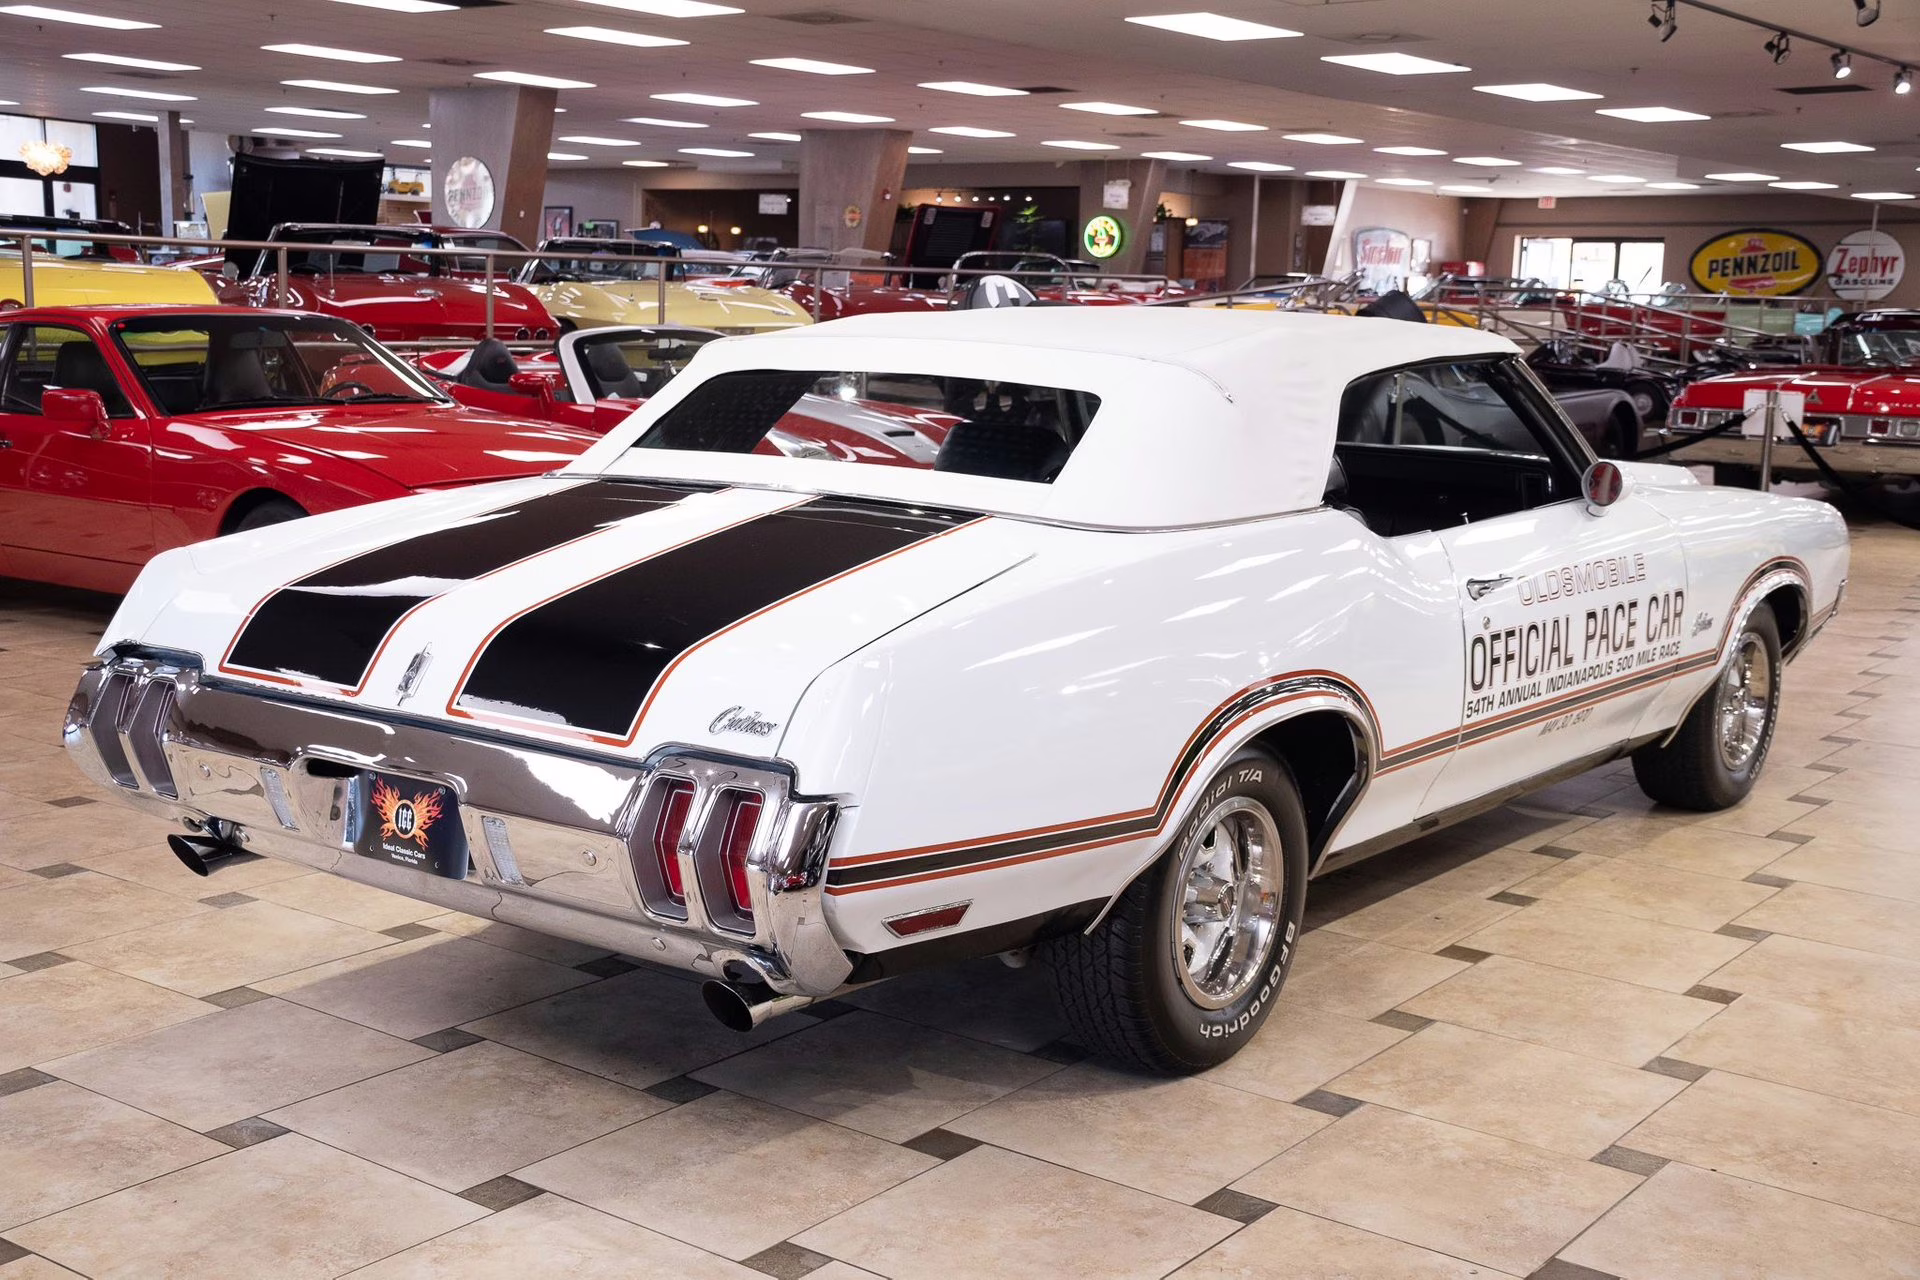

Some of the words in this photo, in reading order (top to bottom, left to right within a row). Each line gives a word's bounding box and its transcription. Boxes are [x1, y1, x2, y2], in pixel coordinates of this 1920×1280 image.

[447, 186, 490, 202] PENNZO
[1707, 250, 1801, 279] PENNZOIL
[1836, 246, 1900, 278] Zephyr
[1834, 277, 1895, 286] GASOLINE
[1517, 552, 1646, 606] OLDSMOBILE
[1470, 613, 1575, 694] OFFICIAL
[1583, 598, 1639, 662] PACE
[1645, 587, 1685, 644] CAR
[1466, 694, 1495, 719] 54TH
[1498, 680, 1542, 709] ANNUAL
[1545, 660, 1614, 695] INDIANAPOLIS
[1616, 653, 1634, 673] 500
[1636, 647, 1657, 666] MILE
[1658, 641, 1681, 659] RACE
[708, 704, 779, 737] Cutlass
[1178, 775, 1233, 862] Radial
[1238, 768, 1263, 783] T/A
[383, 843, 395, 852] Ideal
[395, 845, 413, 856] Classic
[413, 851, 426, 860] Cars
[1199, 921, 1297, 1039] BFGoodrich
